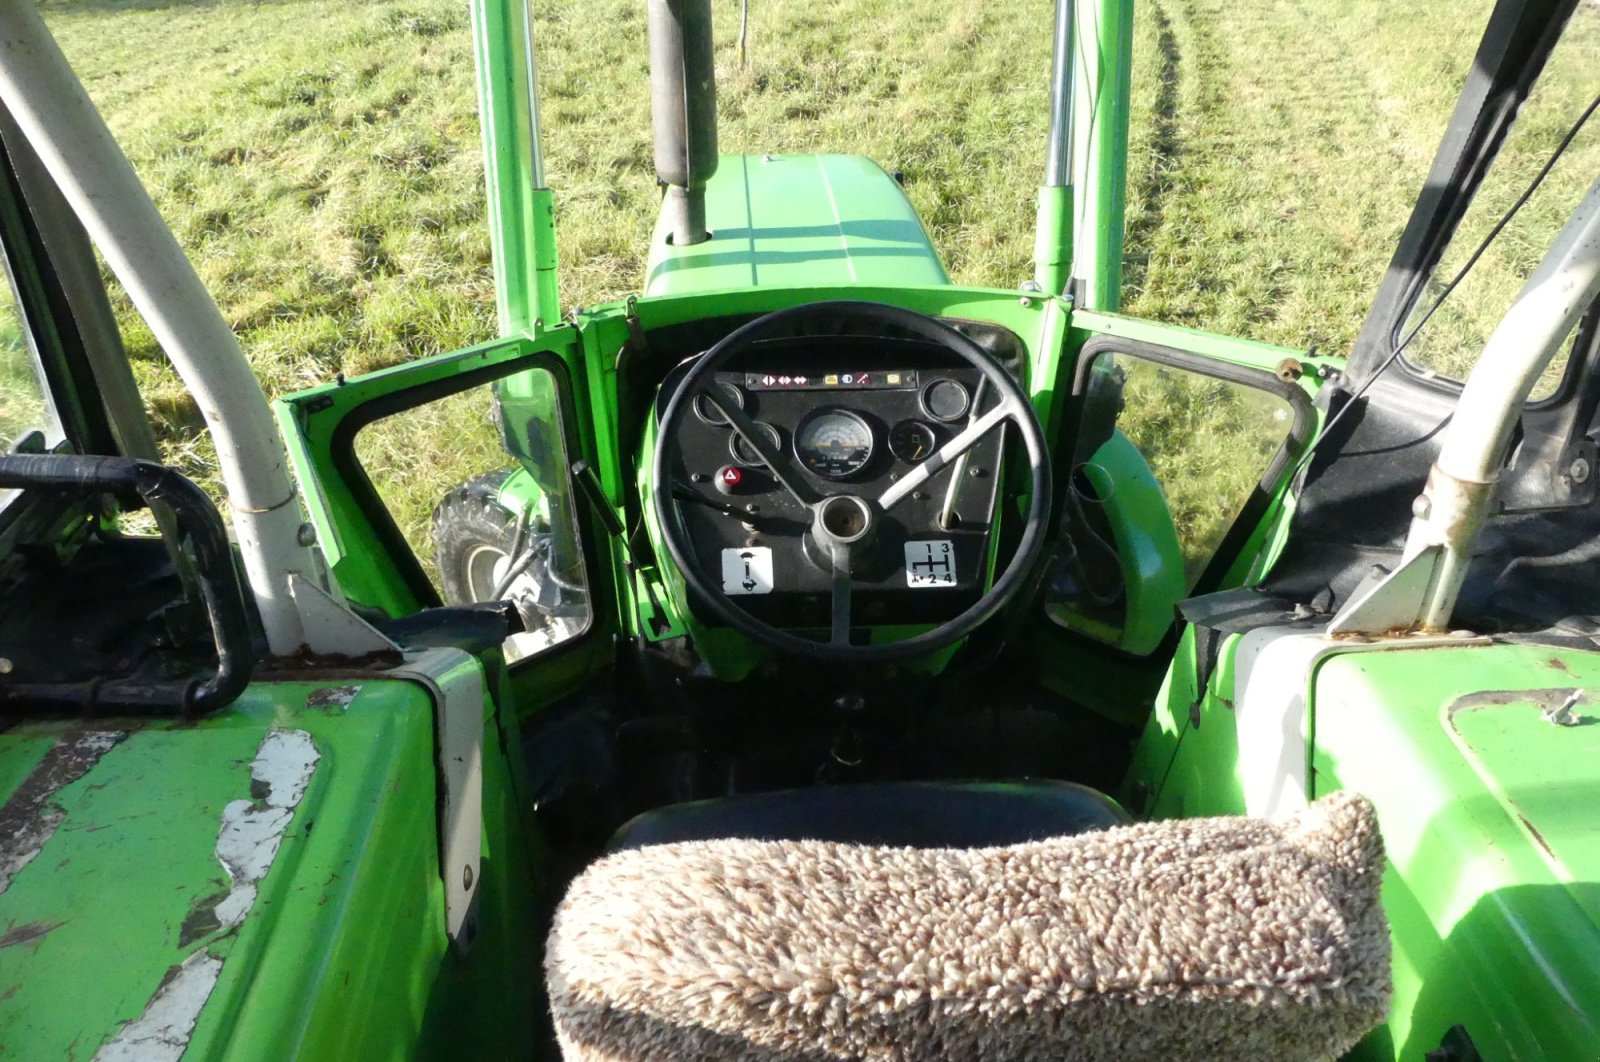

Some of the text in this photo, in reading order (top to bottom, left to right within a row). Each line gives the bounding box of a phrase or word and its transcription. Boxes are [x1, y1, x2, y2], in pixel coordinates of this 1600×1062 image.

[925, 543, 950, 554] 1 3
[928, 573, 953, 584] 2 4
